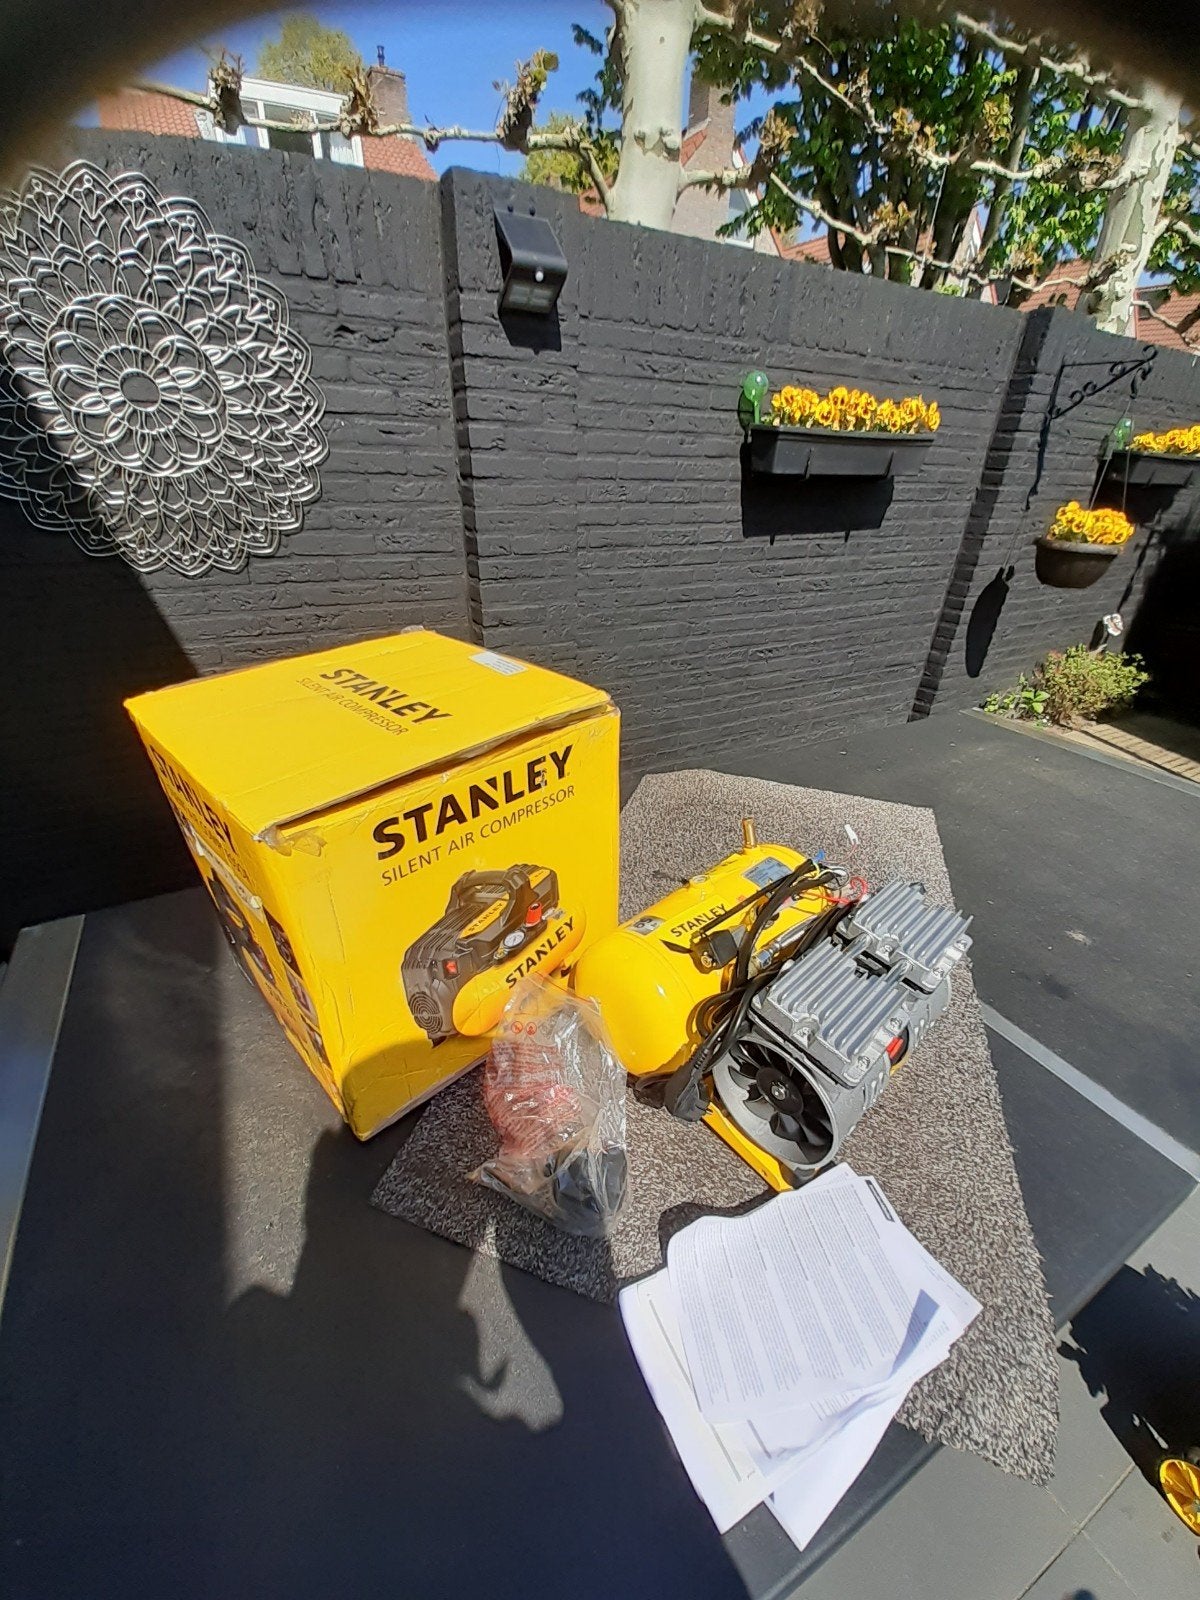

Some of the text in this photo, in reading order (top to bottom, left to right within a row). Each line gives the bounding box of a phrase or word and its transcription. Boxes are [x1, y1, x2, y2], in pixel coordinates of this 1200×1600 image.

[319, 668, 453, 724] STANLEY
[338, 699, 409, 736] COMPRESSOR
[372, 745, 573, 861] STANLEY
[381, 785, 575, 887] SILENT AIR COMPRESSOR
[505, 916, 575, 989] STANLEY
[670, 903, 729, 939] STANLEY
